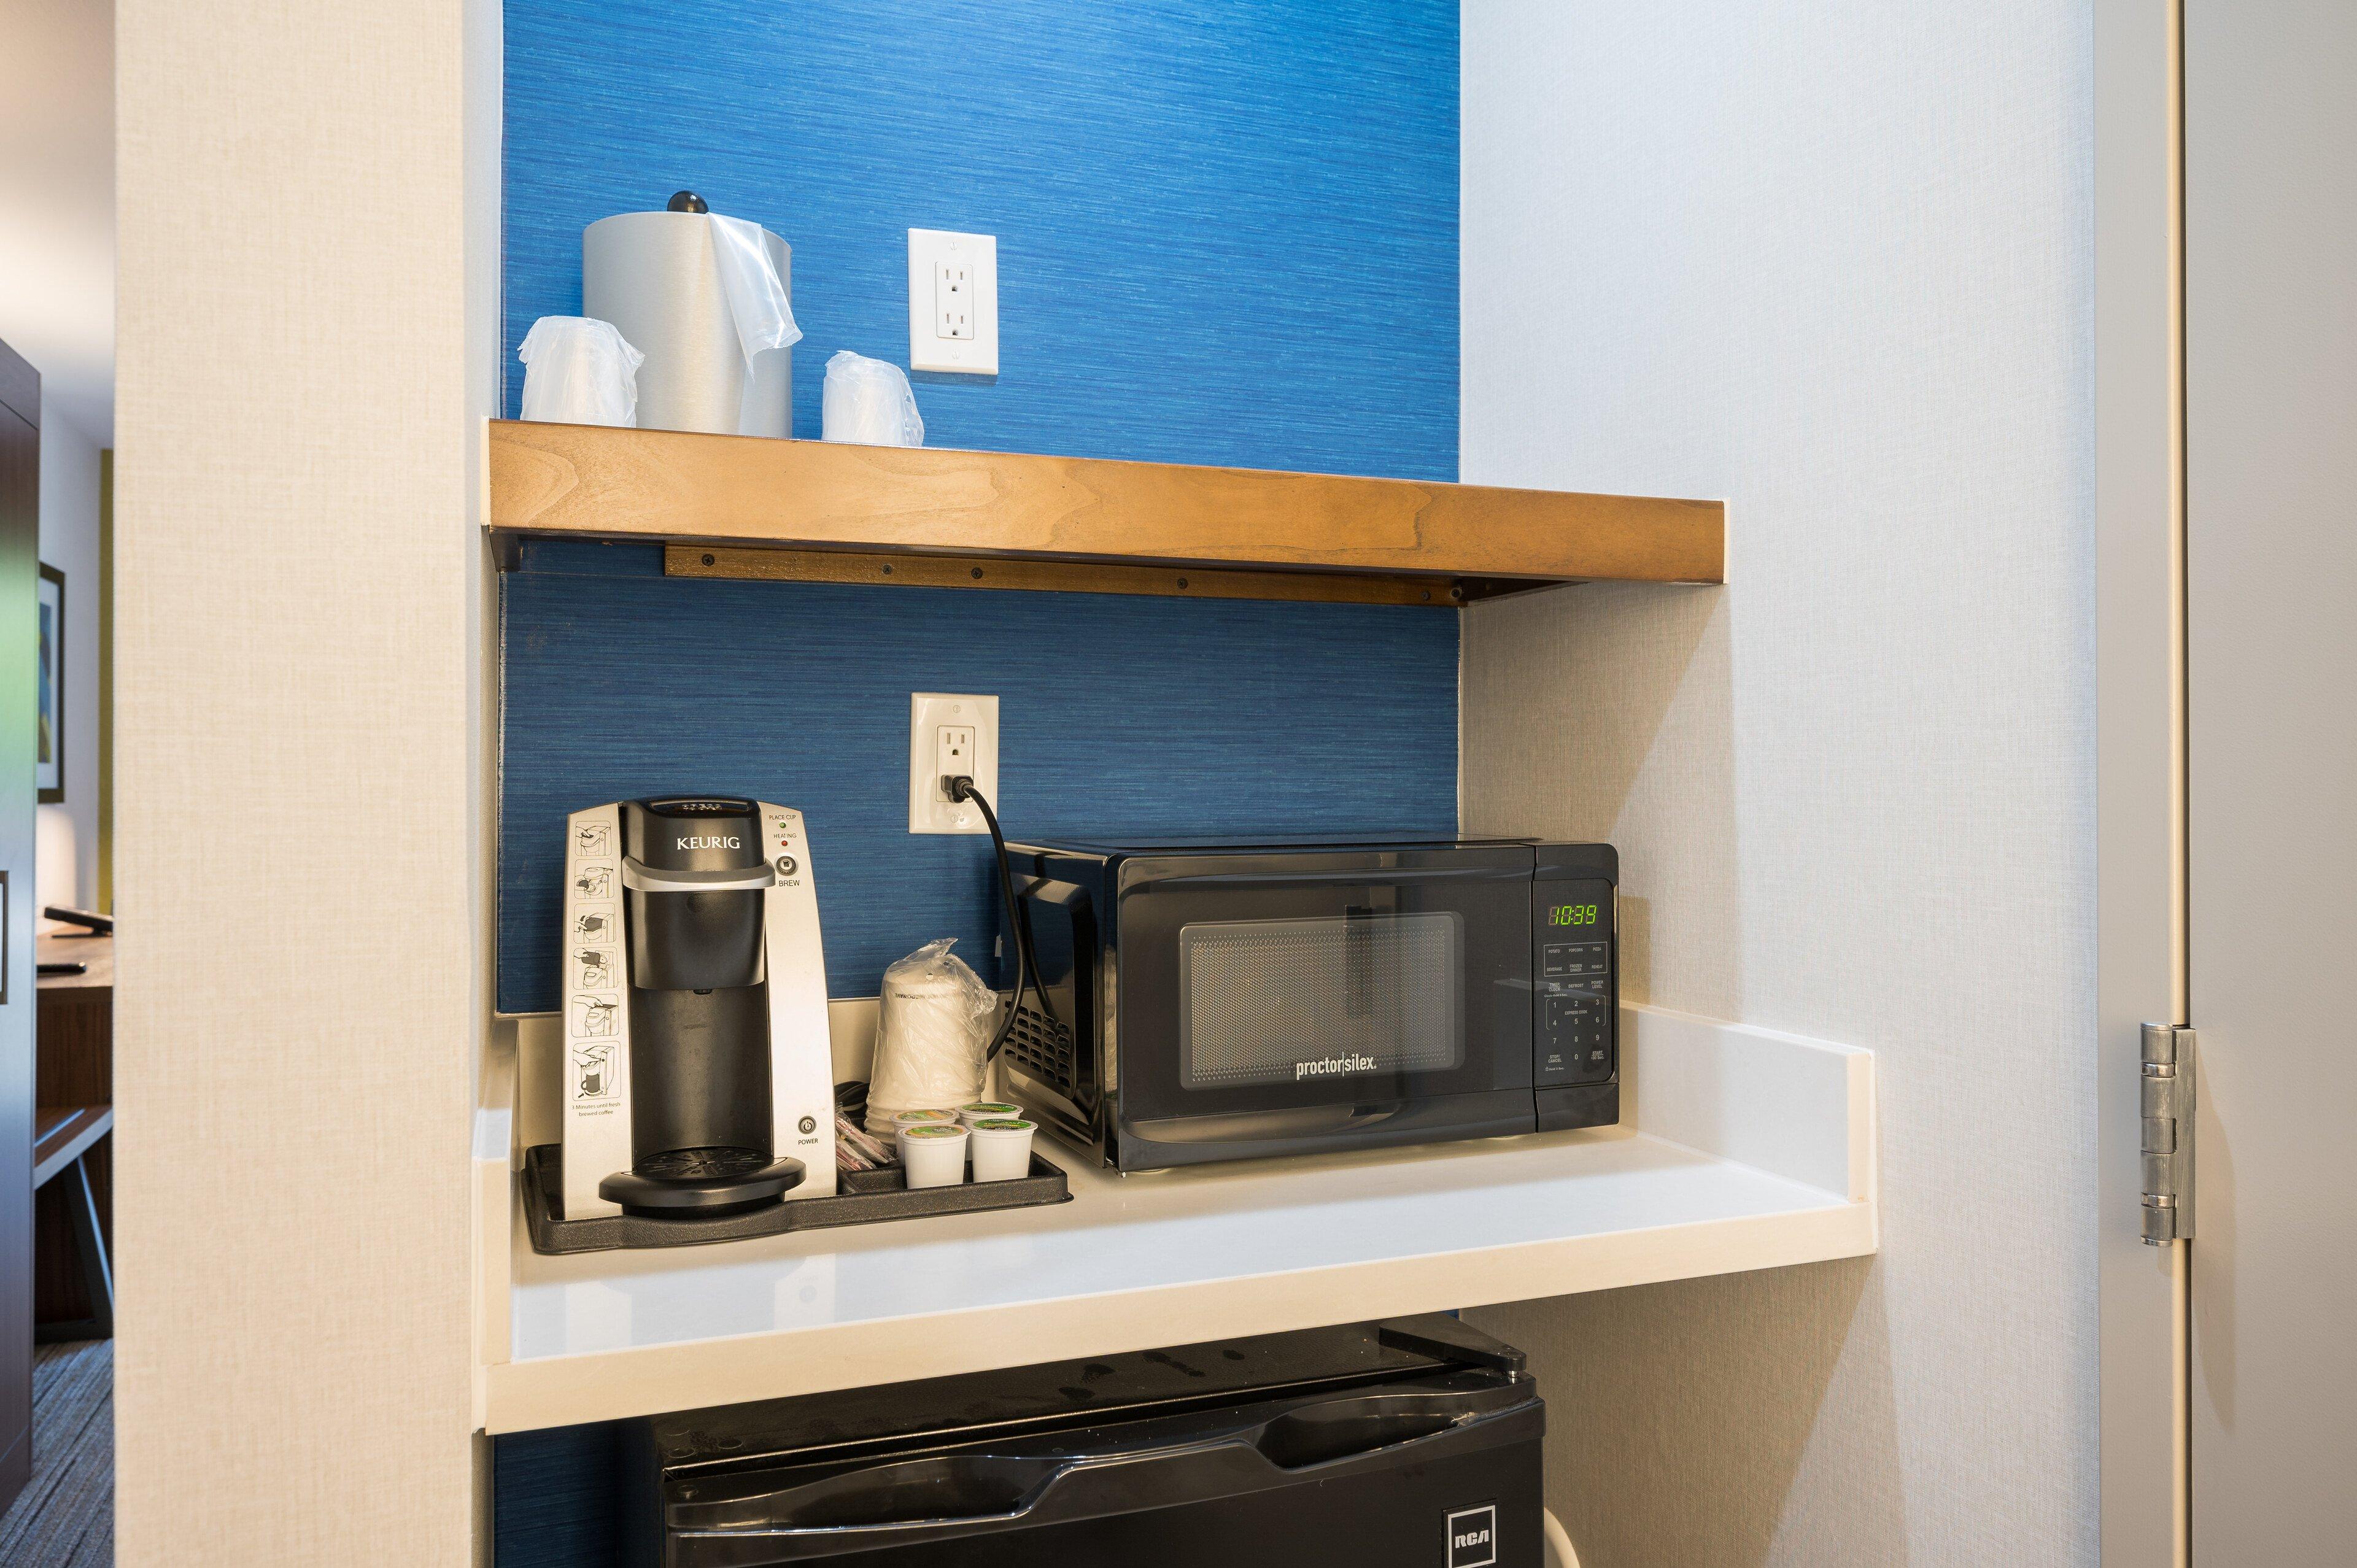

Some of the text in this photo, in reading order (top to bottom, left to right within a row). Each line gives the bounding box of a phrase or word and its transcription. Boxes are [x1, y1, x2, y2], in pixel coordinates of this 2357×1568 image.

[677, 836, 740, 850] KEURIG
[1555, 905, 1597, 925] 10:39
[1455, 1529, 1489, 1548] RCA
